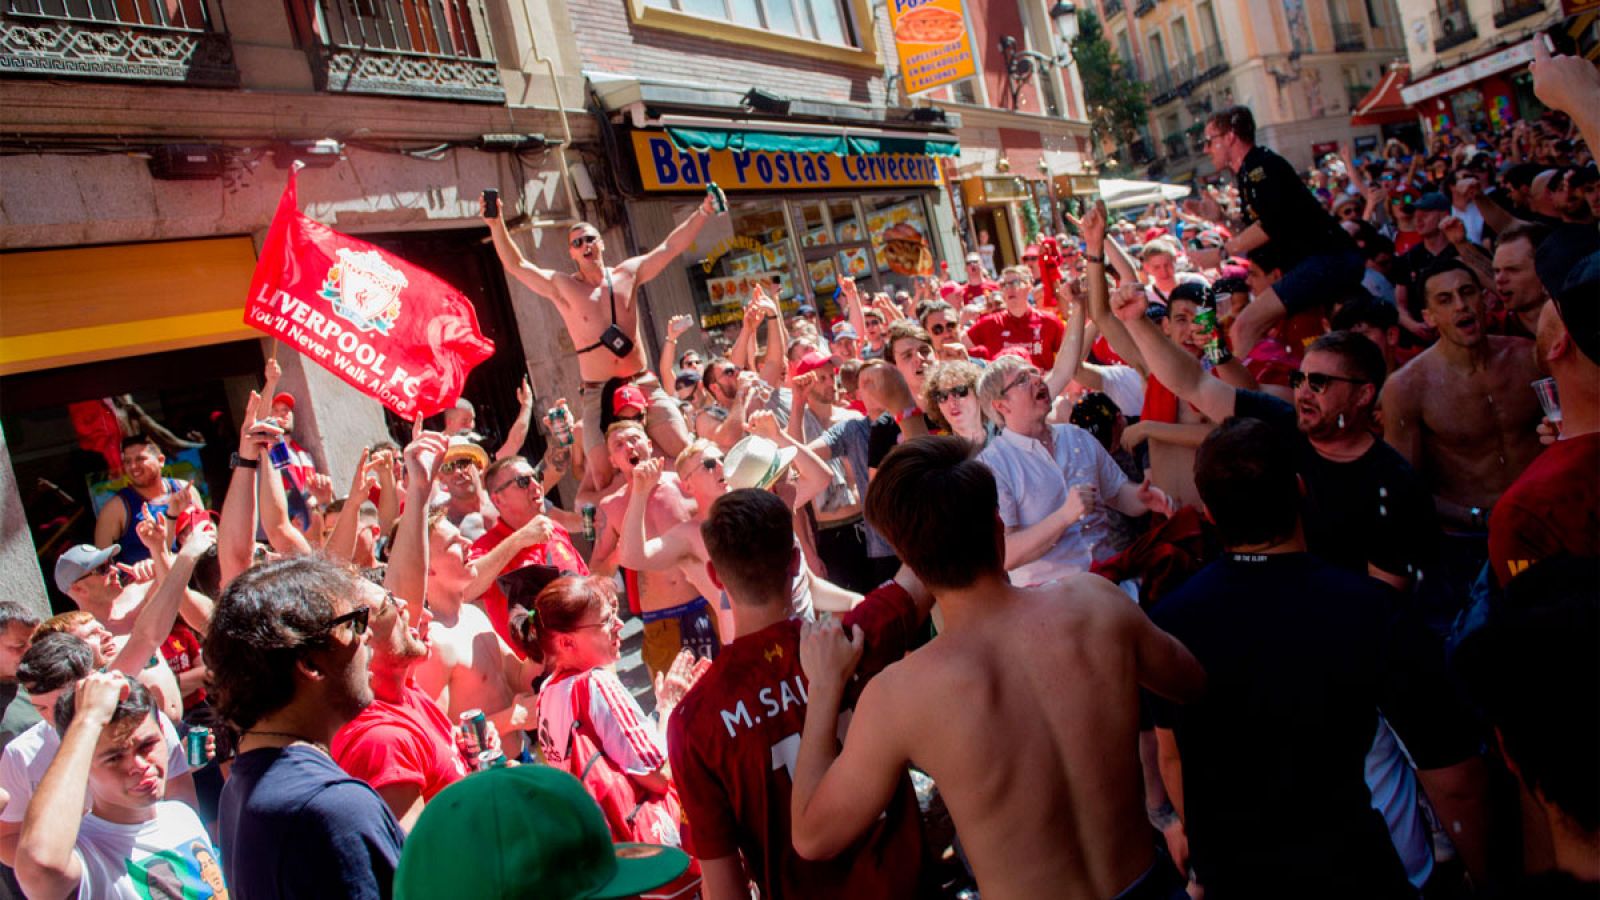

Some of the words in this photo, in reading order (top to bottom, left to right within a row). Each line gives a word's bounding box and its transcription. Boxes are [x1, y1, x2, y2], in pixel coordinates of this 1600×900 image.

[906, 41, 961, 65] ESPECIALIDAD
[908, 67, 919, 78] EN
[920, 51, 970, 74] BOCADILLOS
[911, 79, 917, 89] Y
[919, 67, 957, 86] RACIONES
[650, 138, 712, 184] Bar
[733, 150, 831, 184] Postas
[250, 305, 288, 333] You'll
[287, 324, 332, 359] Never
[334, 351, 368, 384] Walk
[367, 378, 407, 411] Alone
[256, 283, 387, 377] LIVERPOOL
[389, 366, 420, 398] FC
